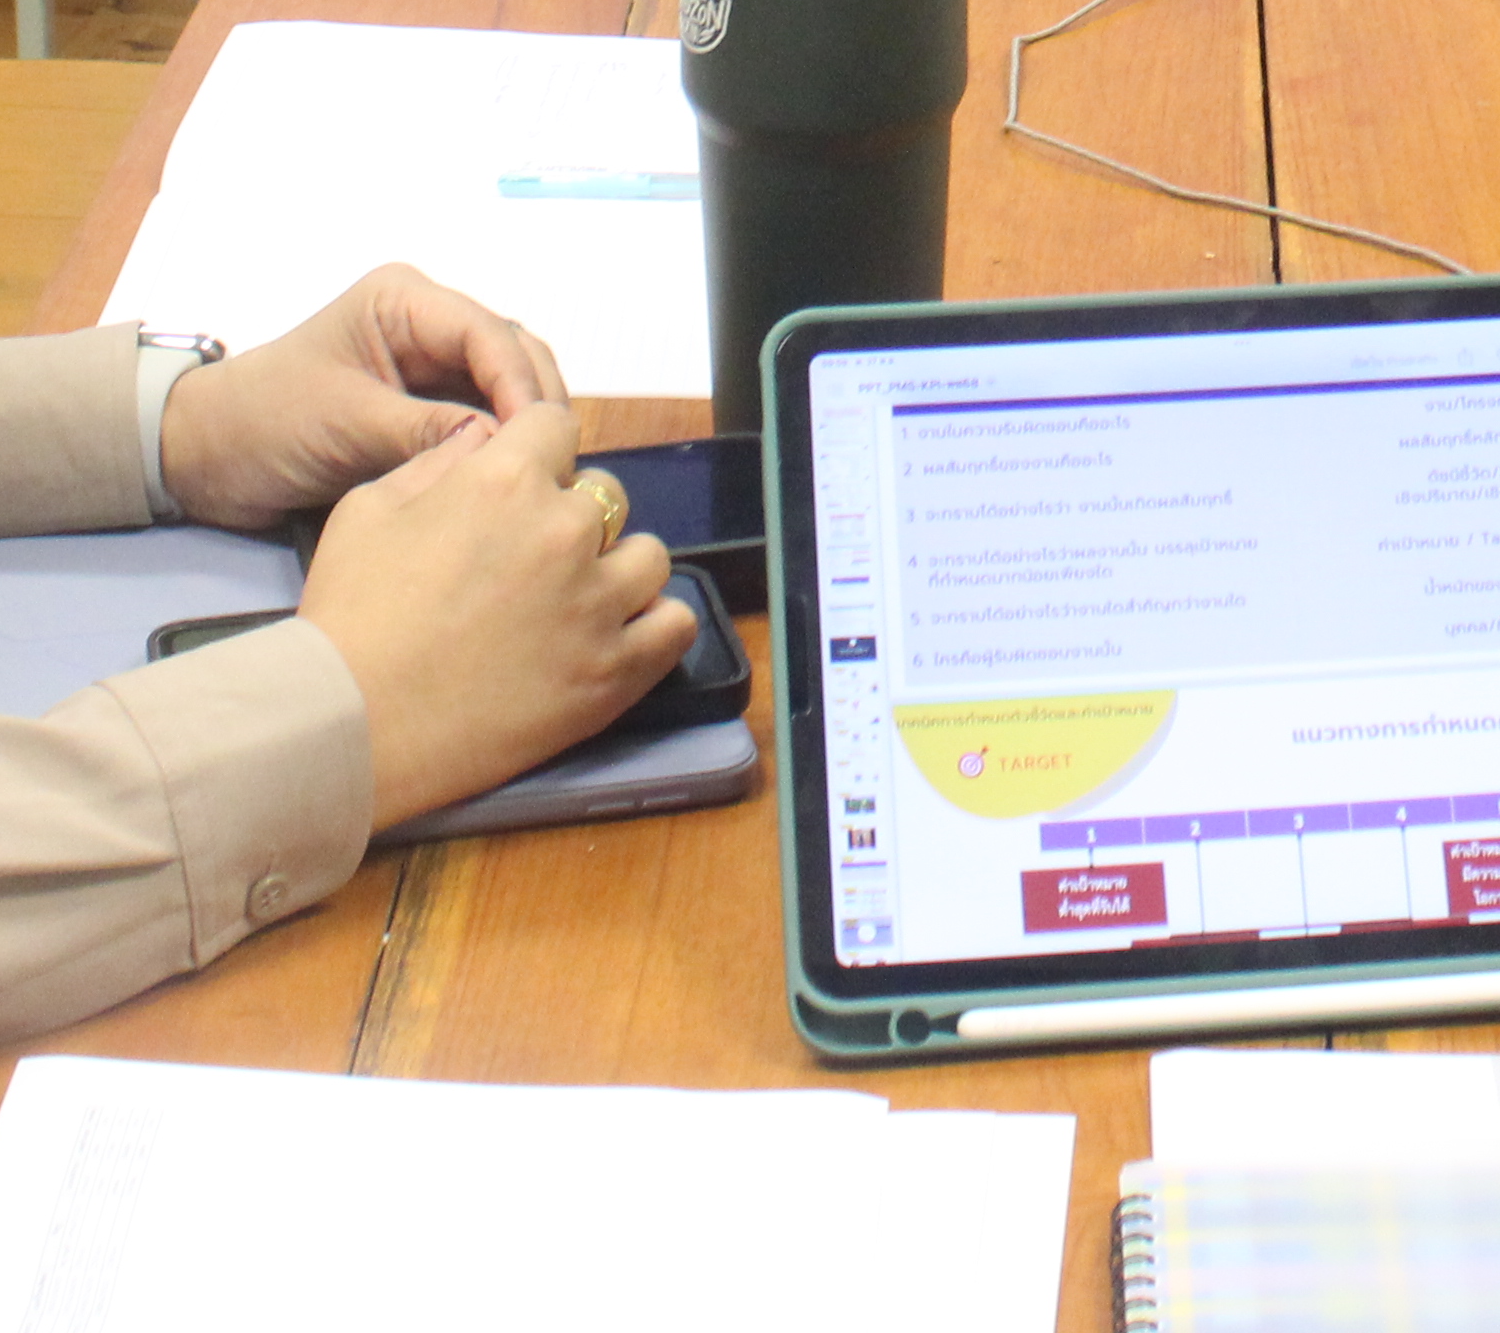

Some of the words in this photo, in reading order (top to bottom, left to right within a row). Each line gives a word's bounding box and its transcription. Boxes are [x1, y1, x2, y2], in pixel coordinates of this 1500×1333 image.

[997, 753, 1074, 774] TARGET
[1189, 821, 1202, 837] 2
[1395, 806, 1408, 823] 4
